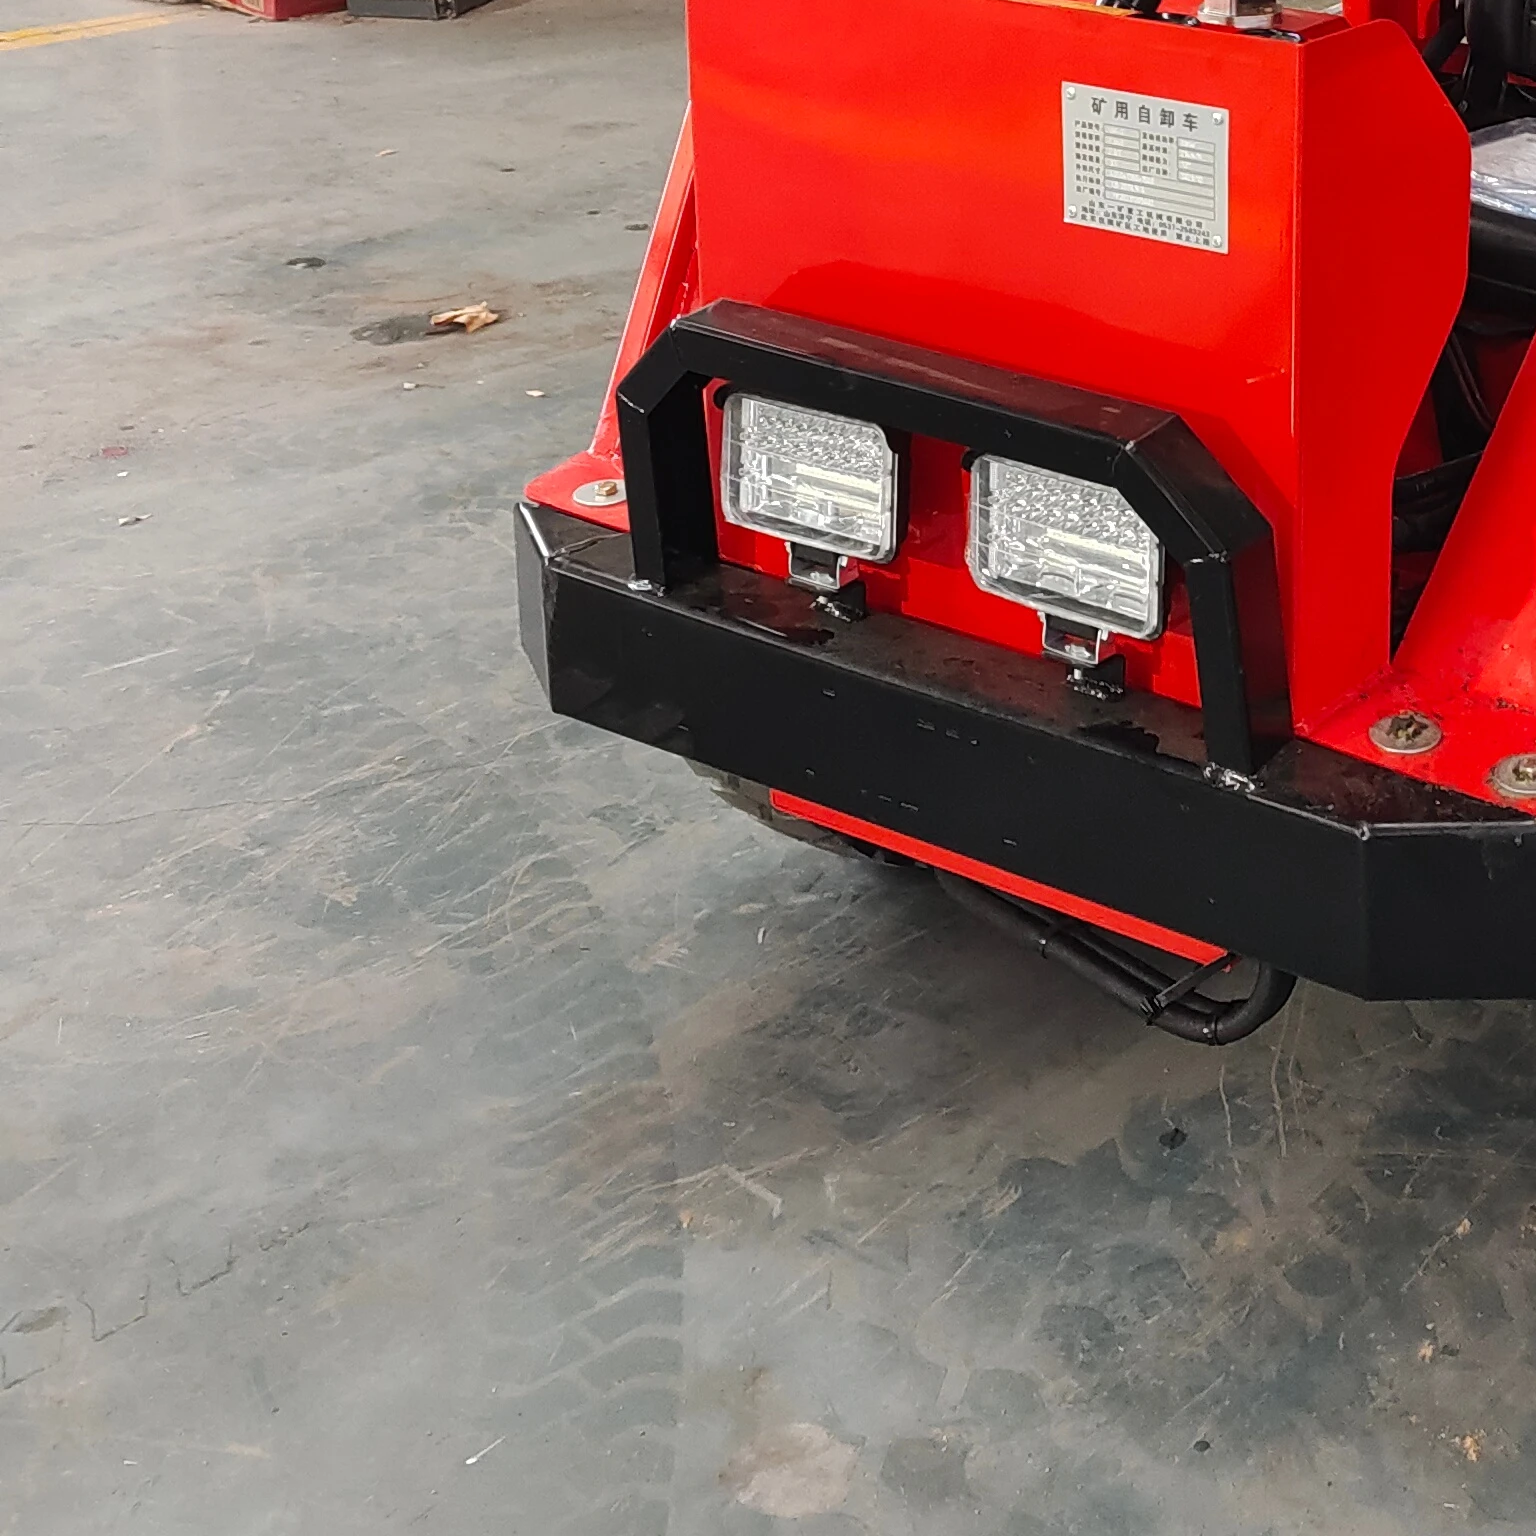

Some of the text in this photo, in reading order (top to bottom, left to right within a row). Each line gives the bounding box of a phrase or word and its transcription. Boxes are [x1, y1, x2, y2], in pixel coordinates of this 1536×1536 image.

[1091, 96, 1198, 132] 矿用自卸车
